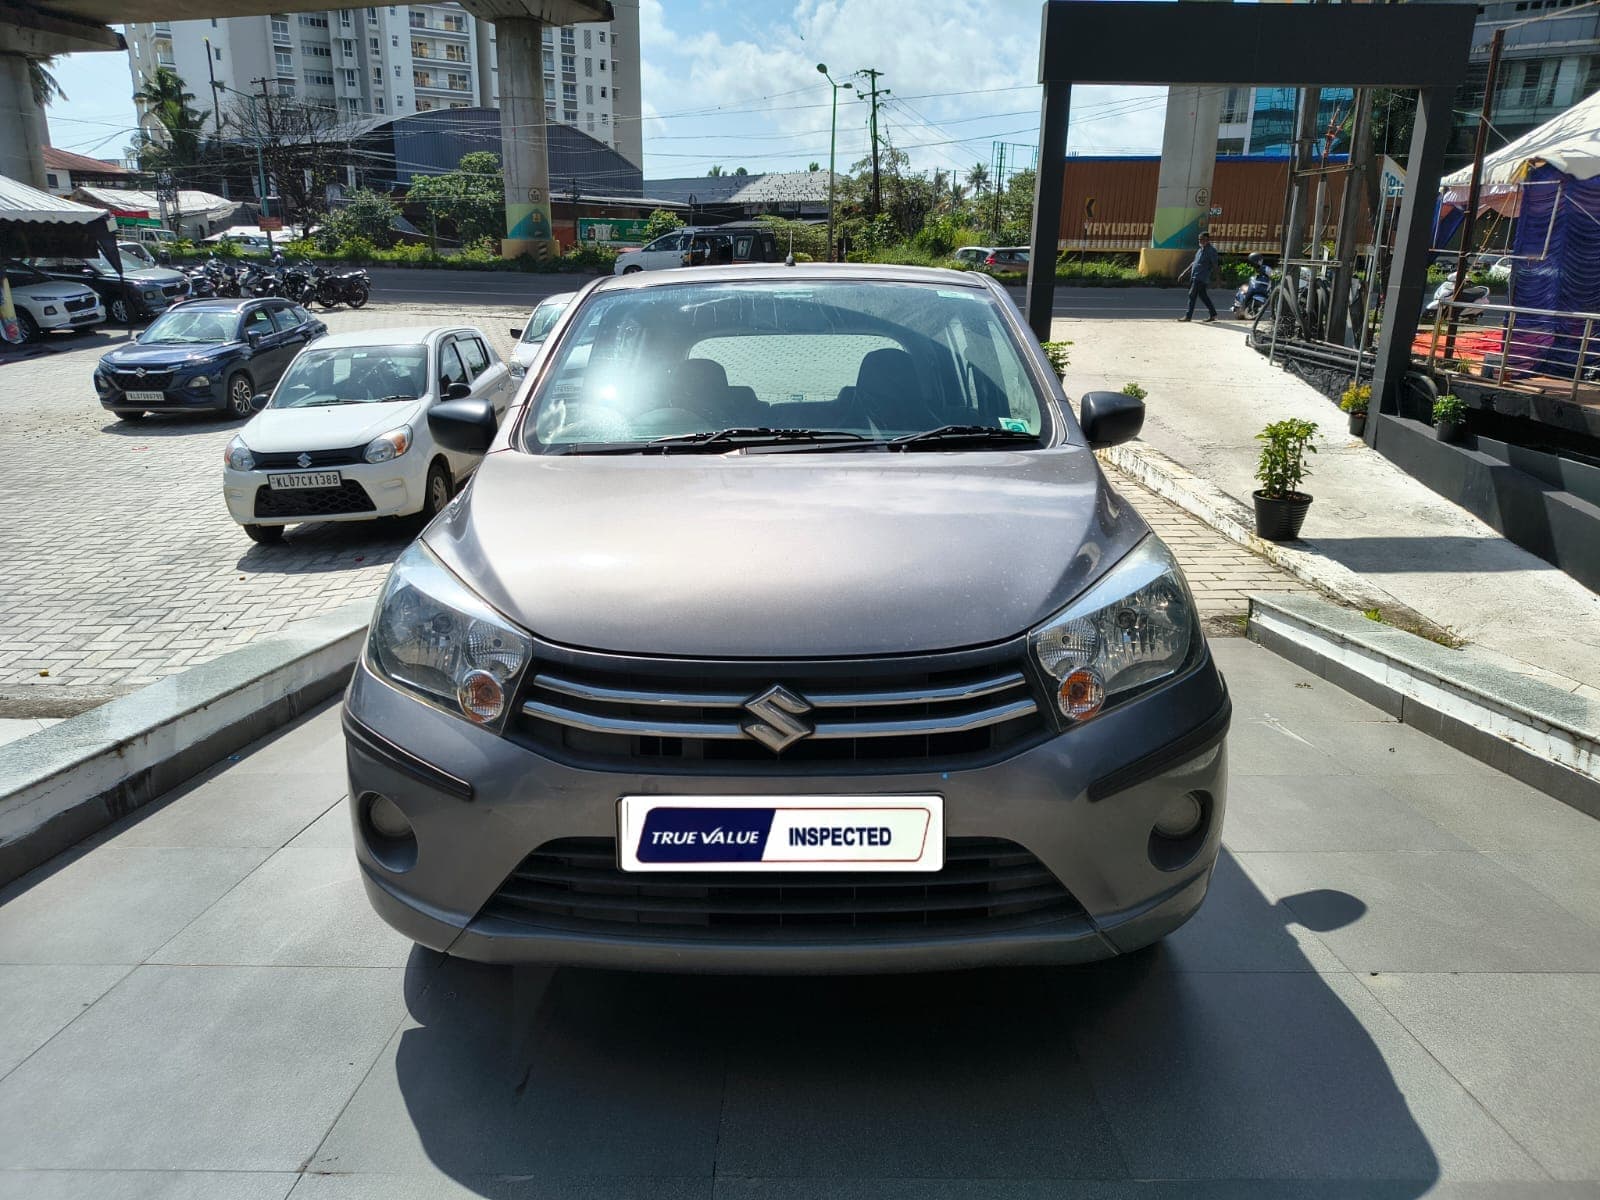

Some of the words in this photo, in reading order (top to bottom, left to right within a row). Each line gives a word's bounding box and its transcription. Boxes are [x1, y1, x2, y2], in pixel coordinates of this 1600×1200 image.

[276, 474, 339, 488] KL07CX1388
[652, 831, 698, 845] TRUE
[701, 827, 760, 845] VALUE
[789, 827, 892, 847] INSPECTED
